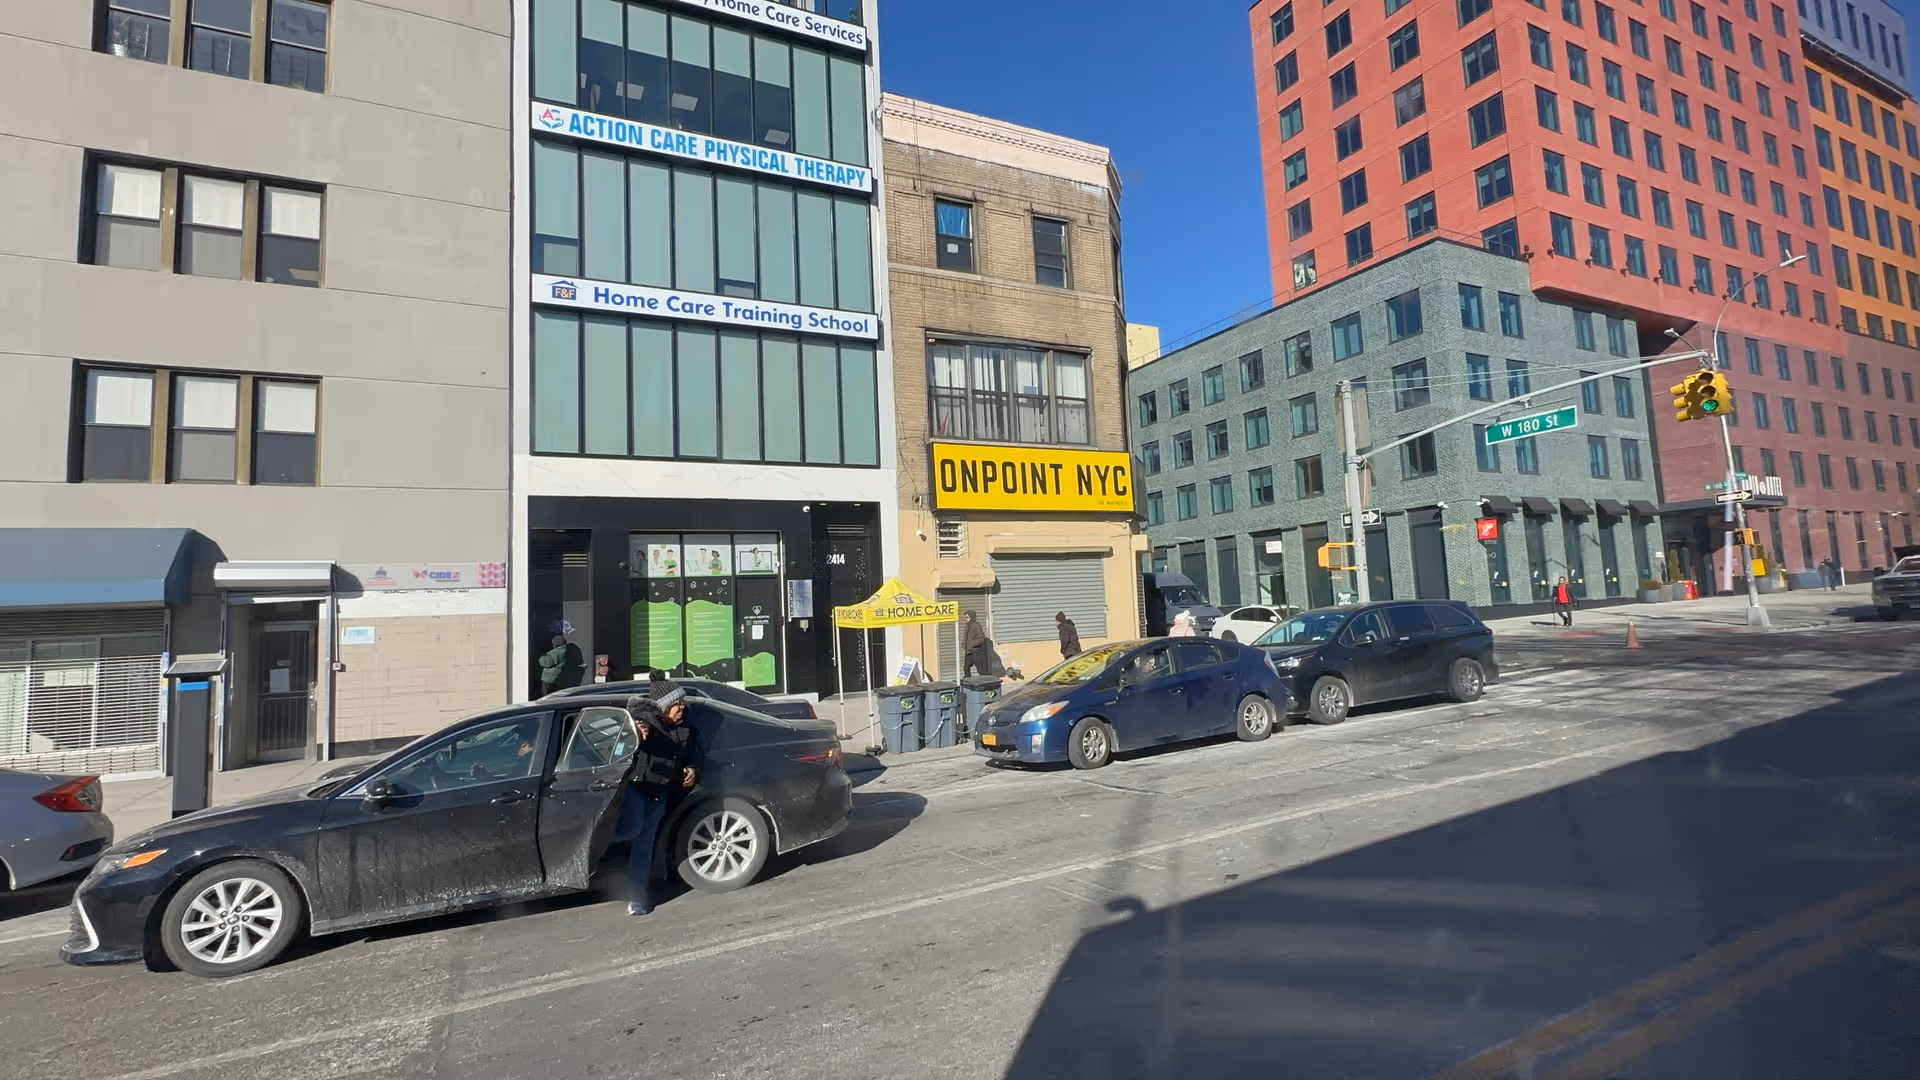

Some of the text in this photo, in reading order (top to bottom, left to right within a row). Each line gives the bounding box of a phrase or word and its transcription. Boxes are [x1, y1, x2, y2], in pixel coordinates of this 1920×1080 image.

[765, 5, 800, 27] Care
[805, 16, 863, 44] Services
[569, 113, 865, 187] ACTION CARE PHYSICAL THERAPY
[555, 287, 576, 299] F&F
[594, 286, 868, 333] Home Care Training School
[1501, 414, 1559, 437] W 180 St
[940, 458, 1127, 496] ONPOINT NYC
[826, 553, 845, 565] 2414
[888, 604, 954, 618] HOME CARE
